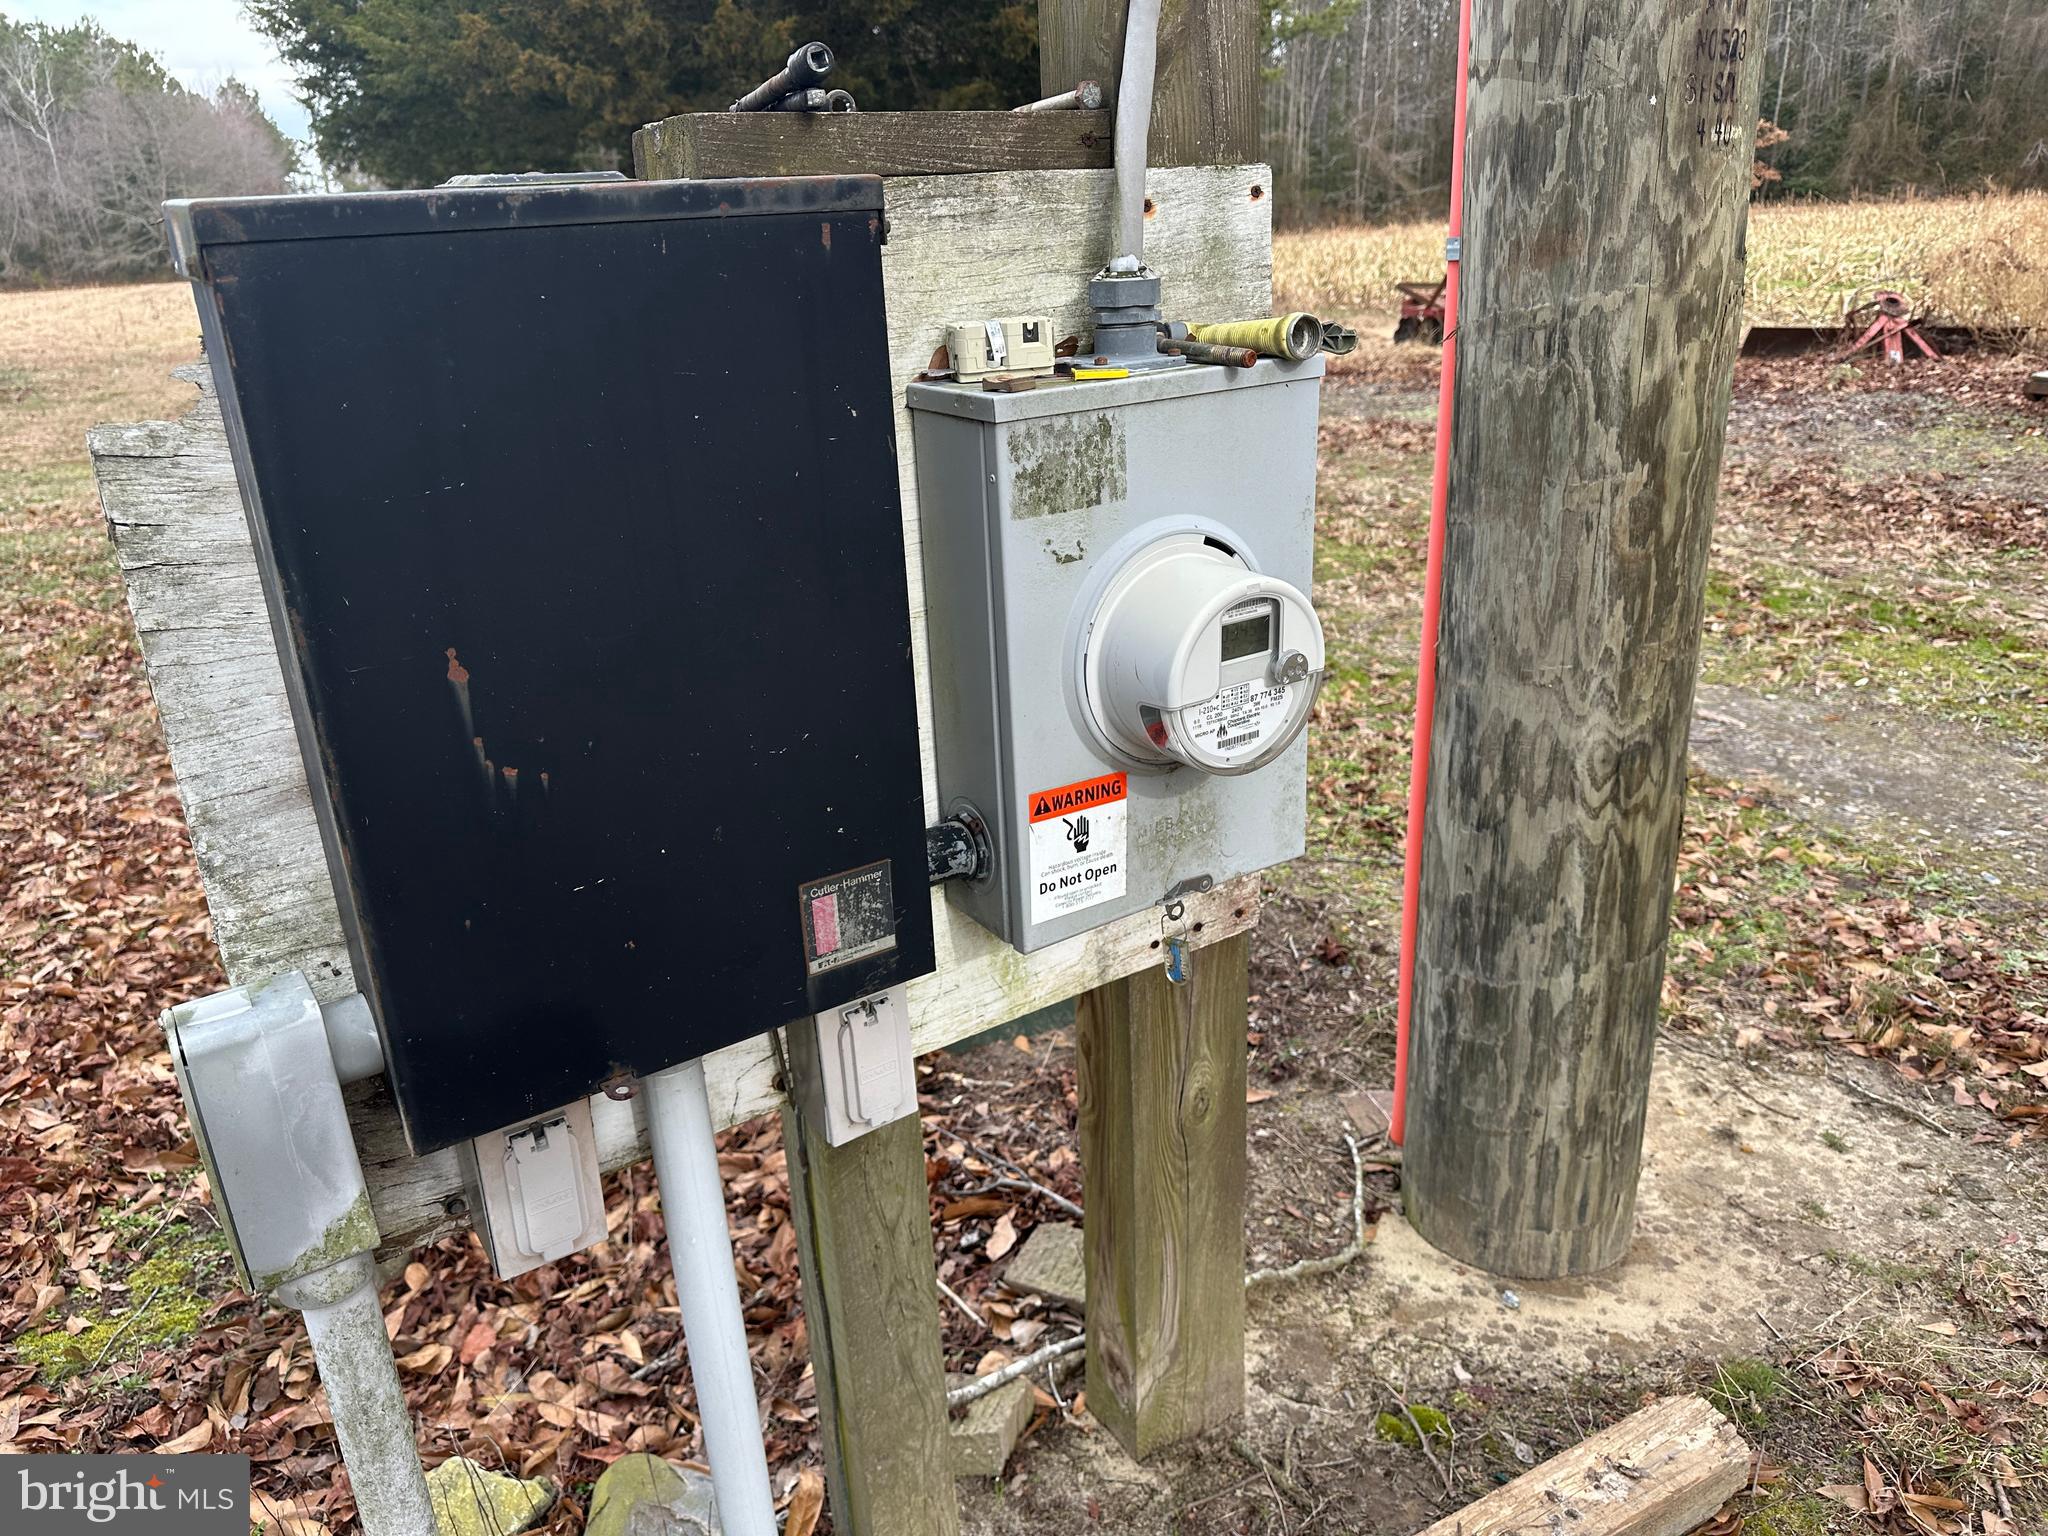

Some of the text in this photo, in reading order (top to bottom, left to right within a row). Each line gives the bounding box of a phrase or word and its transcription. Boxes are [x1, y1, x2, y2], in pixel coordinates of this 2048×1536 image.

[1697, 114, 1732, 147] 4 40
[1250, 686, 1286, 702] 87 774 345
[1051, 780, 1121, 811] WARNING
[810, 870, 883, 898] Cutler-Hammer
[1040, 882, 1056, 895] Do
[1060, 873, 1082, 889] Not
[1085, 864, 1117, 881] Open
